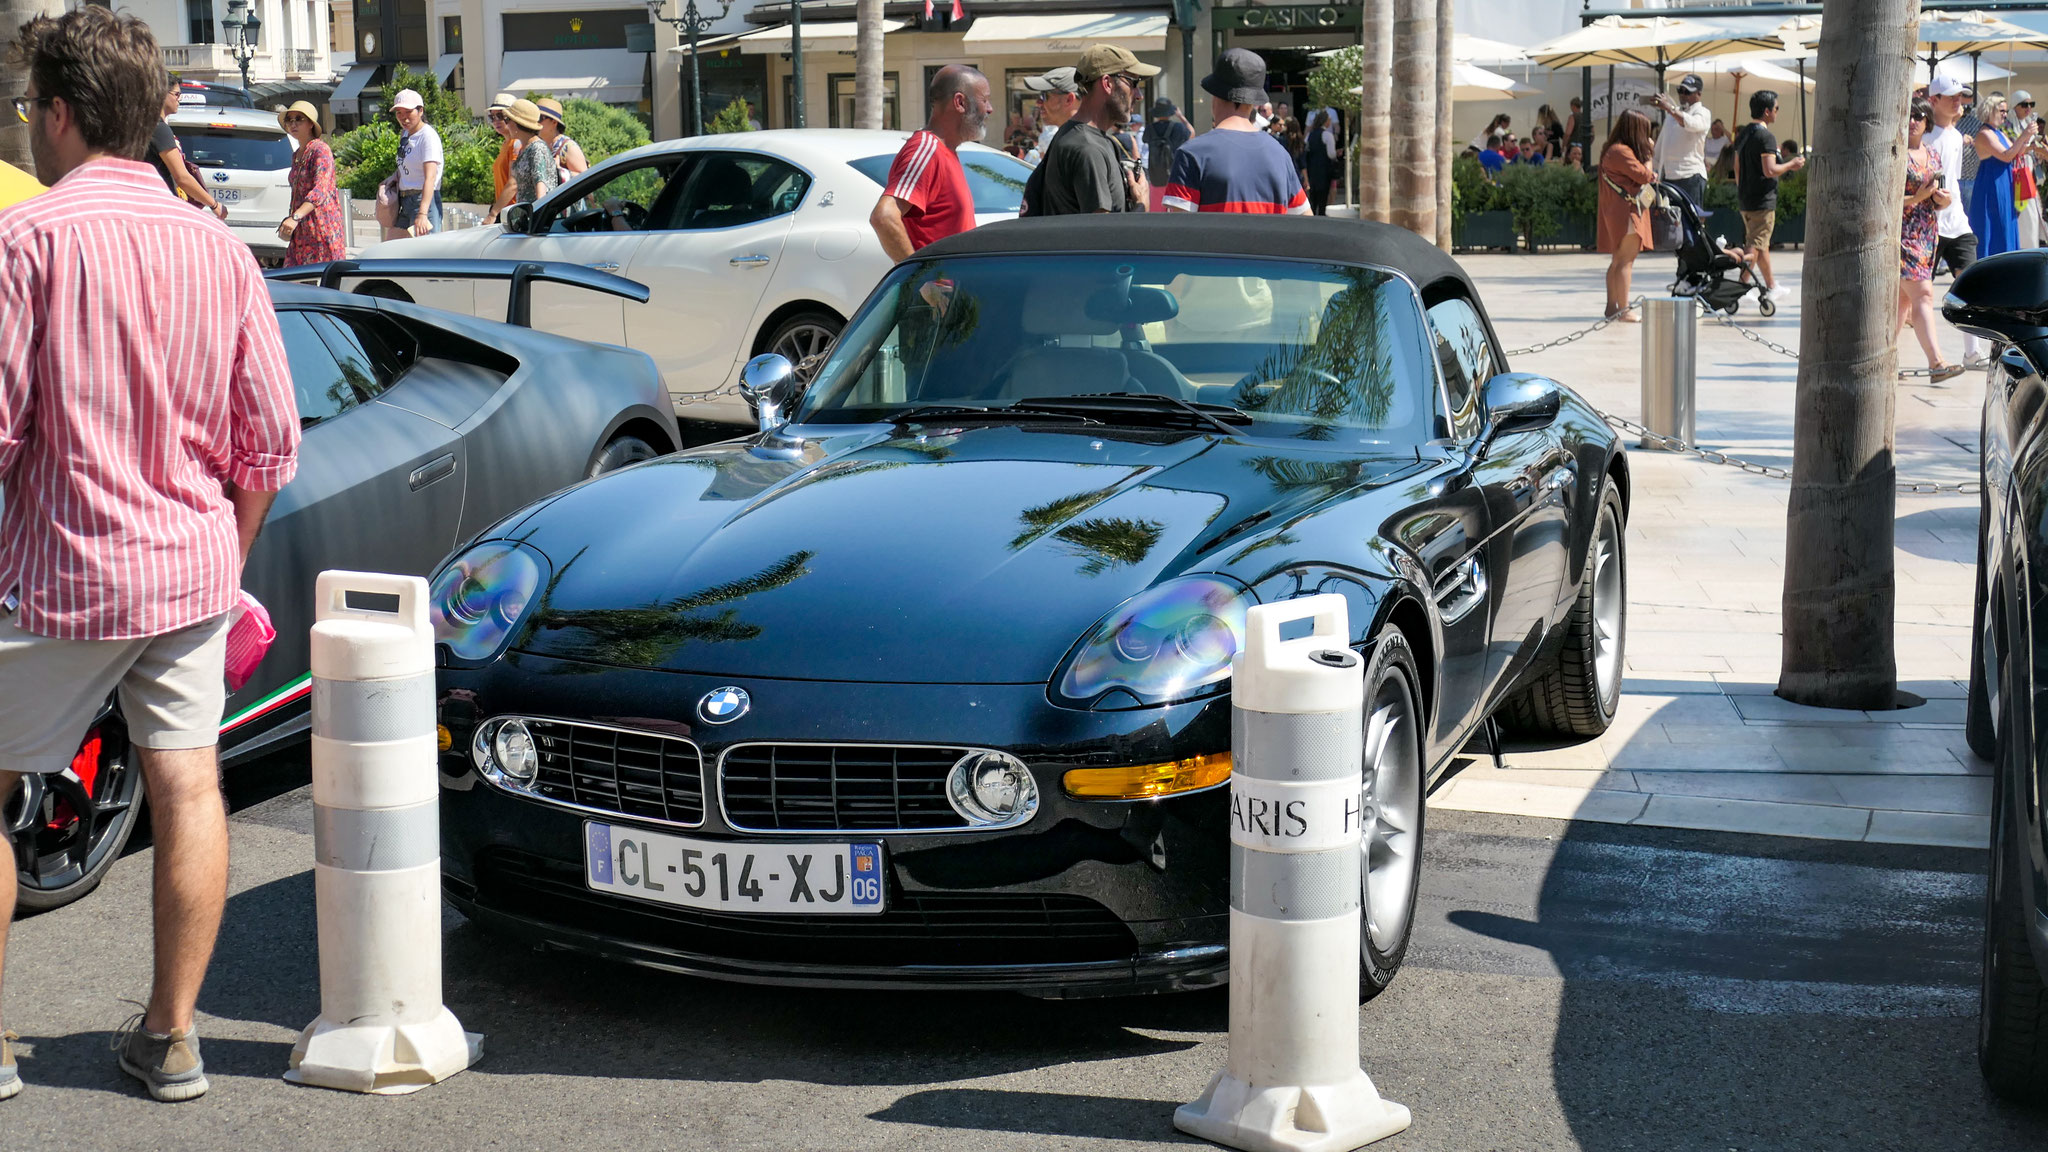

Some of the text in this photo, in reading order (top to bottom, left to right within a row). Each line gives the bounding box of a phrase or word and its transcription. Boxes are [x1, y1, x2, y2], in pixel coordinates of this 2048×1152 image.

[1243, 7, 1338, 27] CASINO
[1616, 91, 1631, 101] DE
[212, 189, 239, 200] 1526
[1230, 792, 1308, 838] ARIS
[597, 860, 605, 873] F
[618, 838, 845, 903] CL-514-XJ
[853, 877, 879, 901] 06
